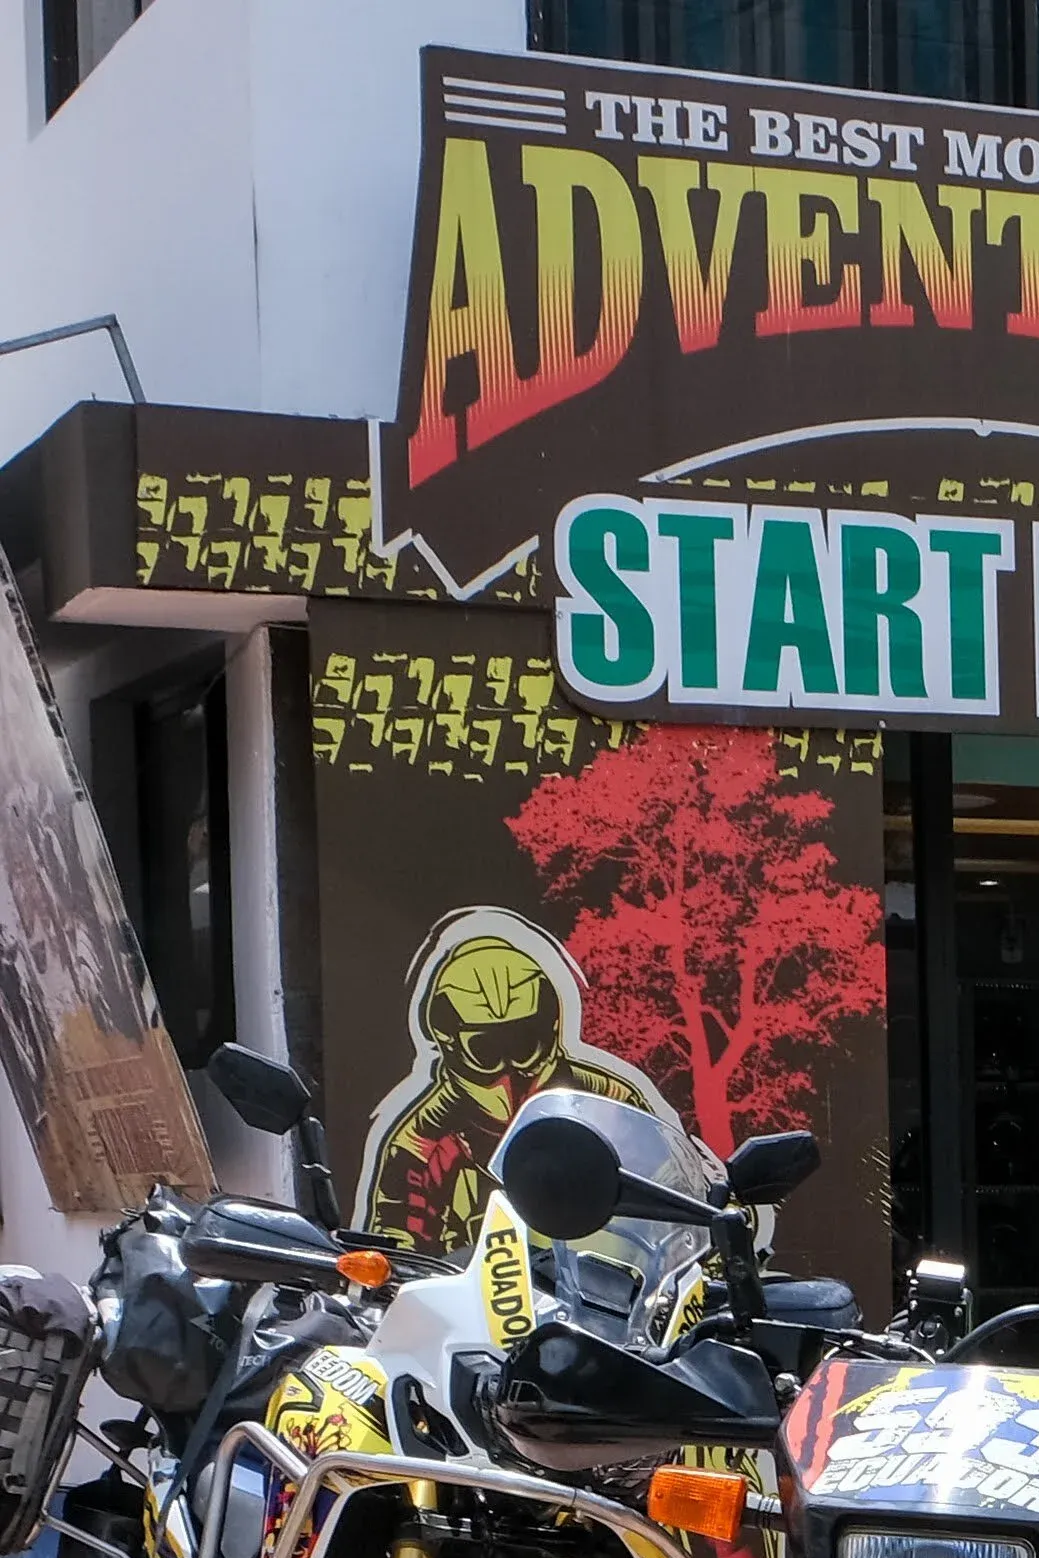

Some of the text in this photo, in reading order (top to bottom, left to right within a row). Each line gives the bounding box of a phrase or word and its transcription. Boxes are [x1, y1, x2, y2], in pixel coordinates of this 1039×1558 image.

[585, 91, 728, 151] THE
[749, 108, 924, 171] BEST
[568, 508, 1004, 700] START
